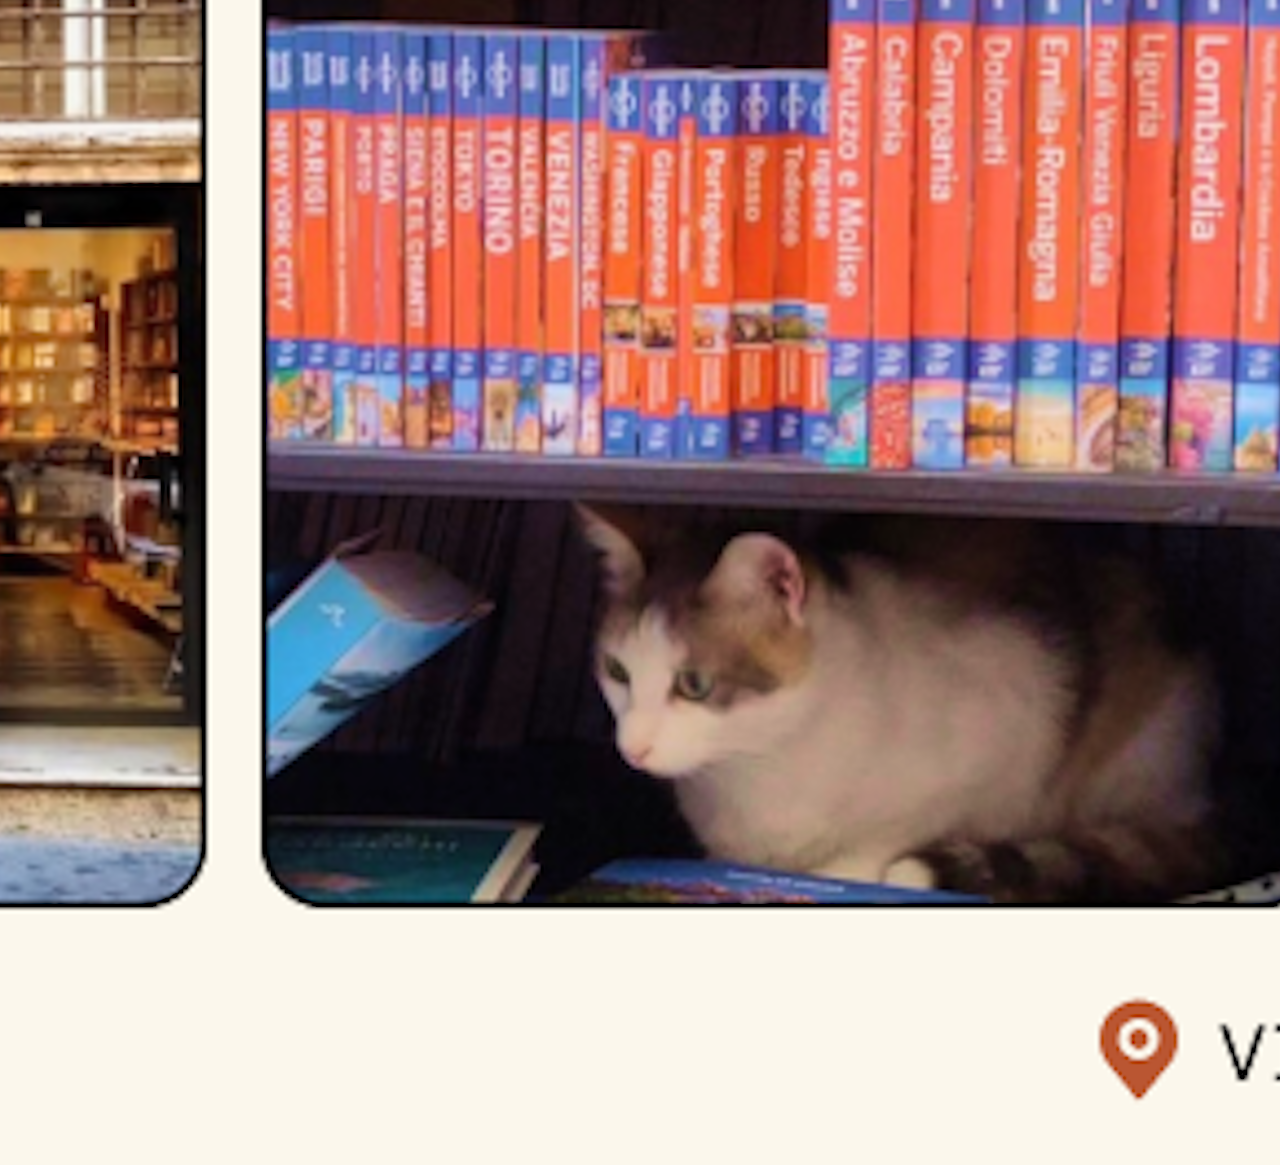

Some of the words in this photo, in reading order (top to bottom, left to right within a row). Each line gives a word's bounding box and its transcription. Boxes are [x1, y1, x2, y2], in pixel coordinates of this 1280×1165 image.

[835, 33, 868, 161] Abruzzo
[881, 36, 910, 157] Calabria
[924, 32, 965, 203] Campania
[982, 37, 1013, 166] Dolomiti
[1093, 36, 1119, 98] Friuli
[1133, 33, 1166, 139] Liguria
[272, 121, 290, 176] NEW
[303, 117, 328, 215] PARIGI
[378, 125, 398, 204] PRAGA
[454, 129, 475, 213] TOKYO
[484, 126, 513, 254] TORINO
[744, 144, 769, 223] Russo
[838, 170, 859, 188] e
[1026, 36, 1070, 303] Emilia-Romagna
[1091, 105, 1118, 205] Venezia
[1189, 35, 1230, 243] Lombardia
[273, 184, 293, 248] YORK
[546, 131, 571, 262] VENEZIA
[613, 141, 637, 255] Francese
[646, 148, 675, 298] Giapponese
[699, 148, 728, 289] Portoghese
[780, 143, 806, 249] Tedesco
[834, 197, 865, 299] Molise
[275, 255, 294, 311] CITY
[1088, 213, 1115, 287] Giulia
